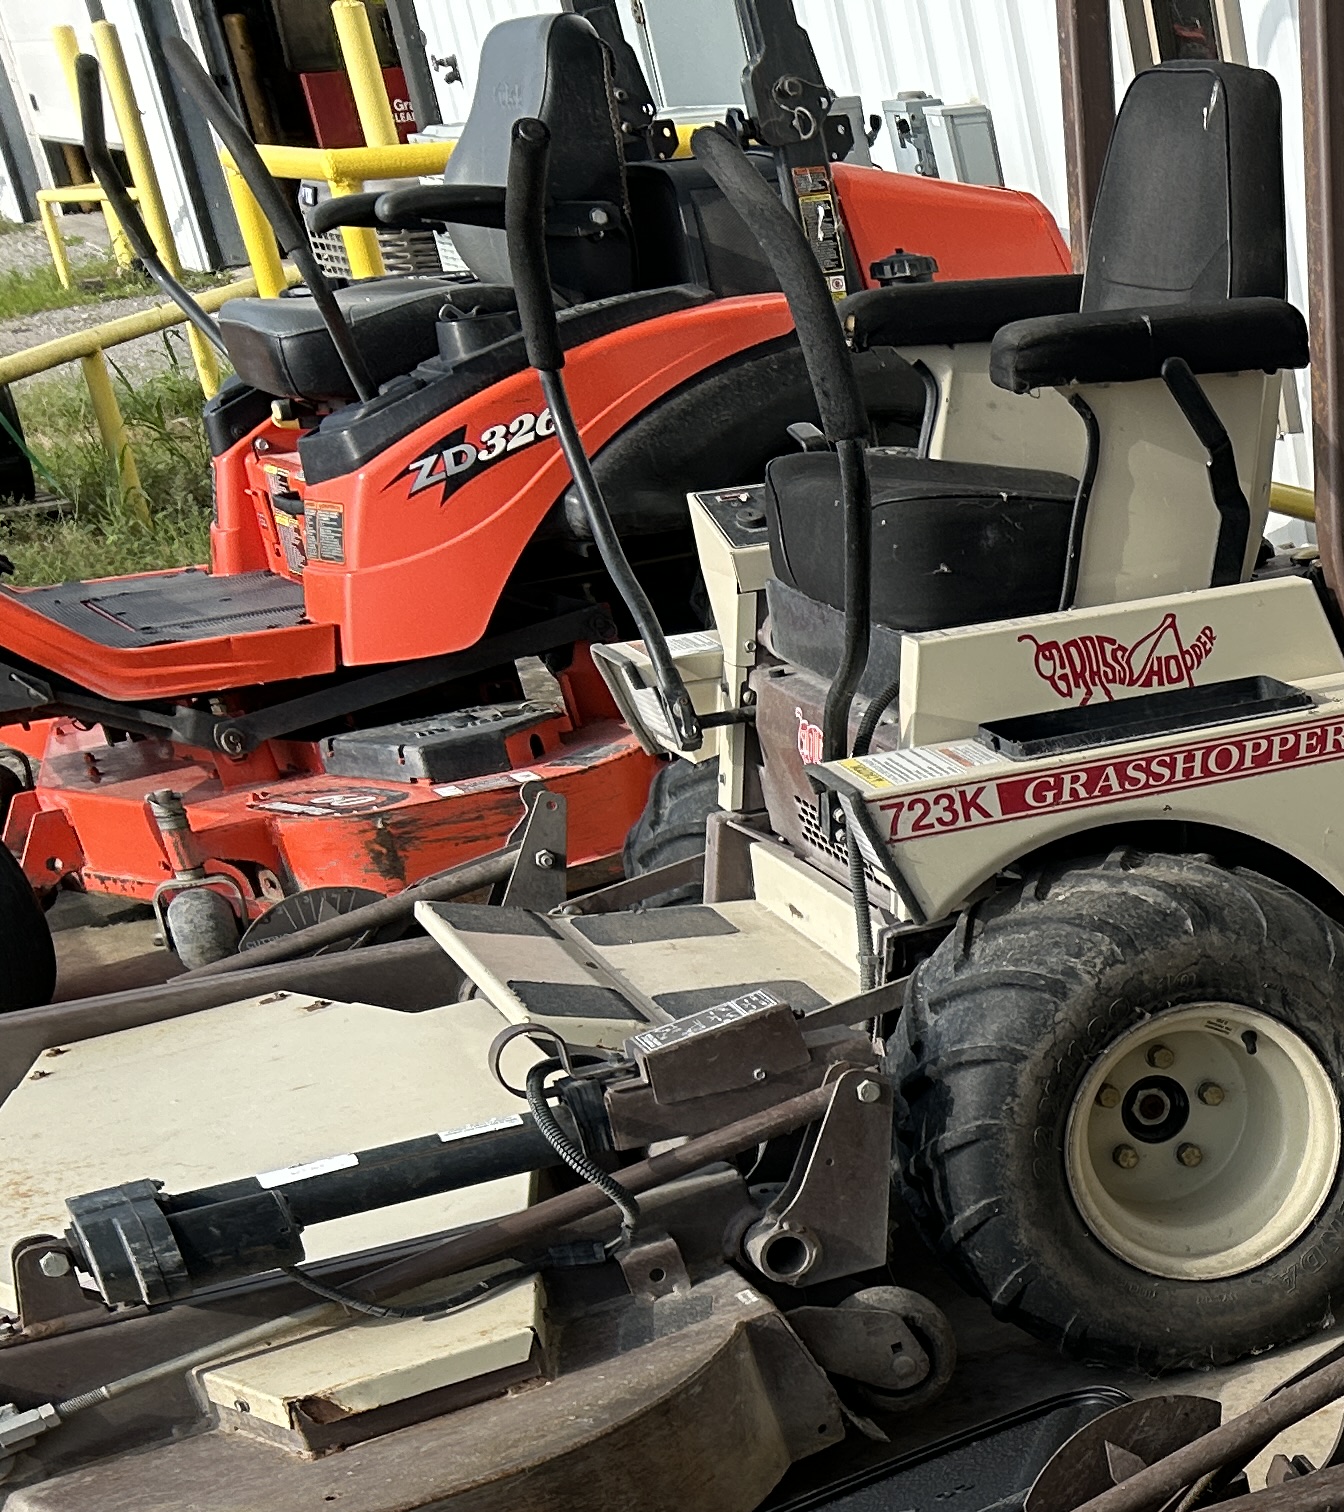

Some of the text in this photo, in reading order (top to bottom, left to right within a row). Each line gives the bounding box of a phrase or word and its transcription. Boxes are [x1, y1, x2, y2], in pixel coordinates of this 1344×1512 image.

[409, 408, 555, 494] ZD326
[1030, 622, 1217, 700] GRASSHOPPER
[880, 786, 994, 836] 723K
